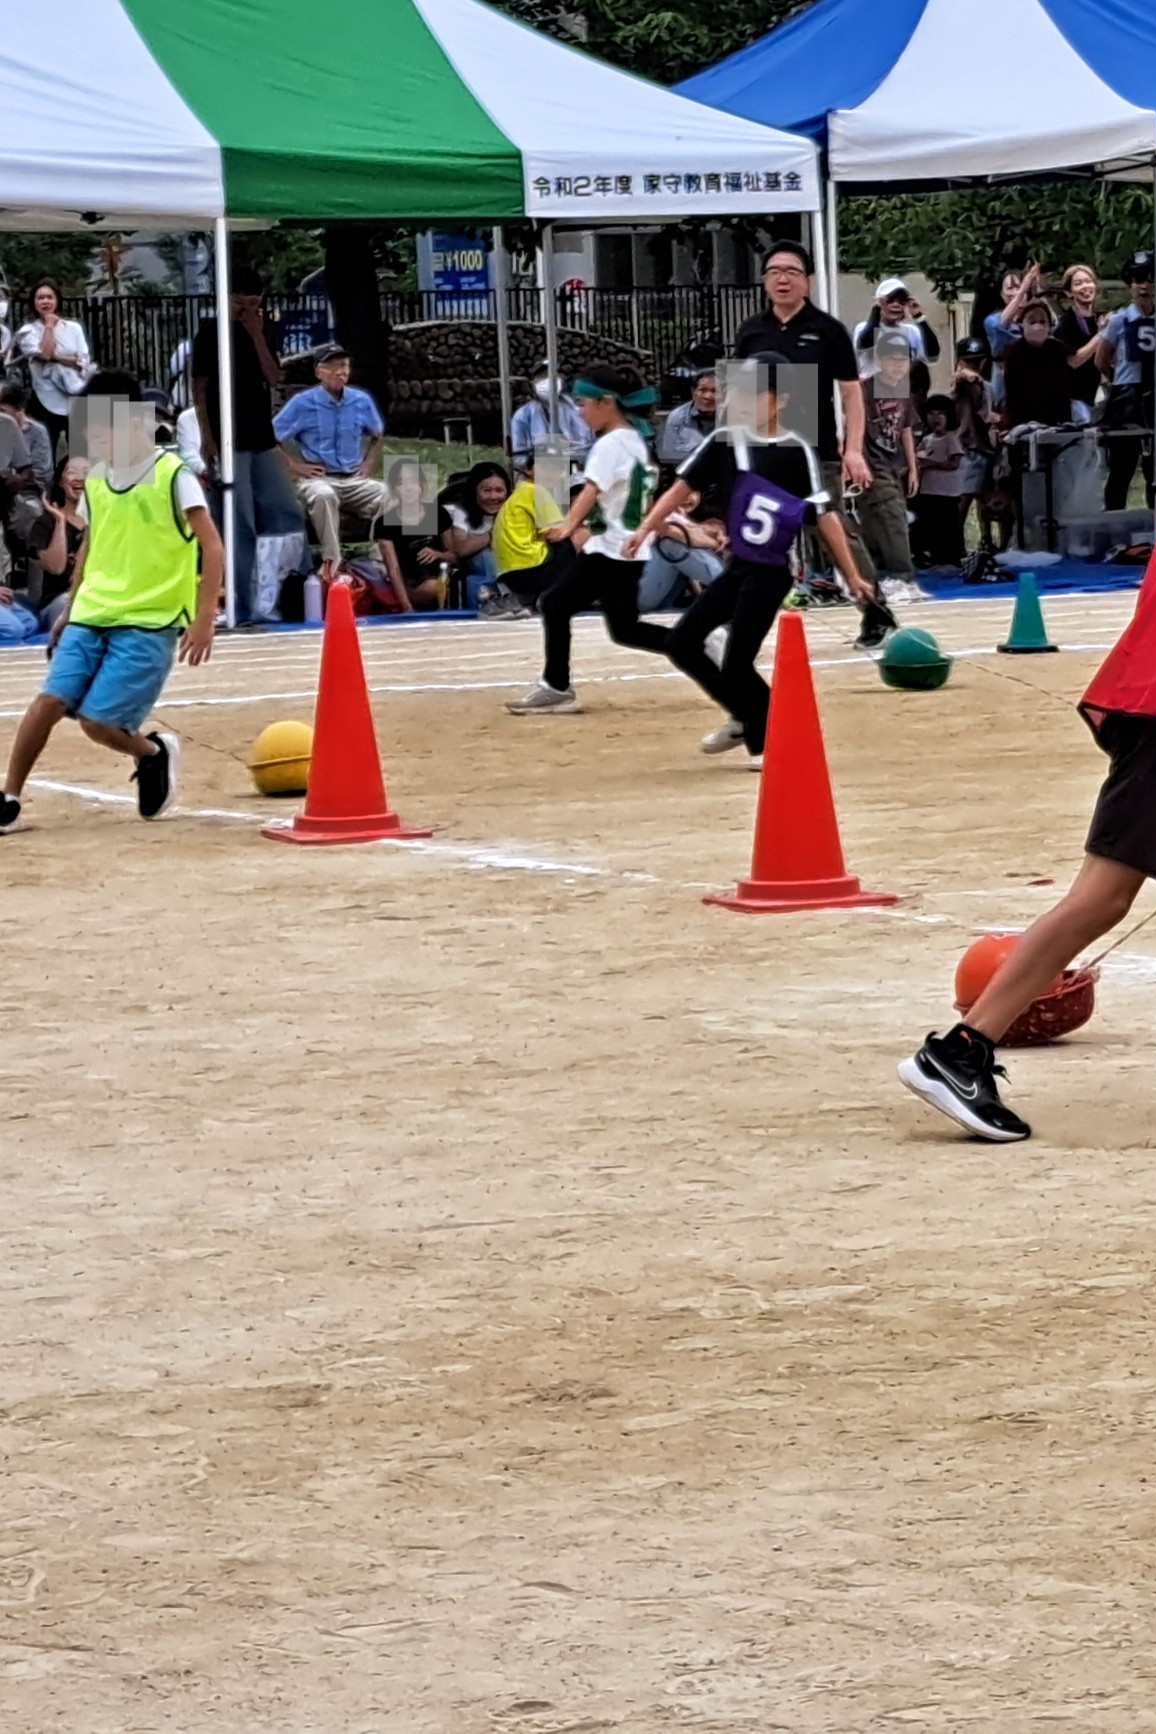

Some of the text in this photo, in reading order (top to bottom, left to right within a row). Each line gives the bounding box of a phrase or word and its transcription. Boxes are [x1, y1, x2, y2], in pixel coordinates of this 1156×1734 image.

[532, 175, 633, 198] 令和2年度
[1137, 325, 1156, 351] 5
[740, 494, 780, 545] 5
